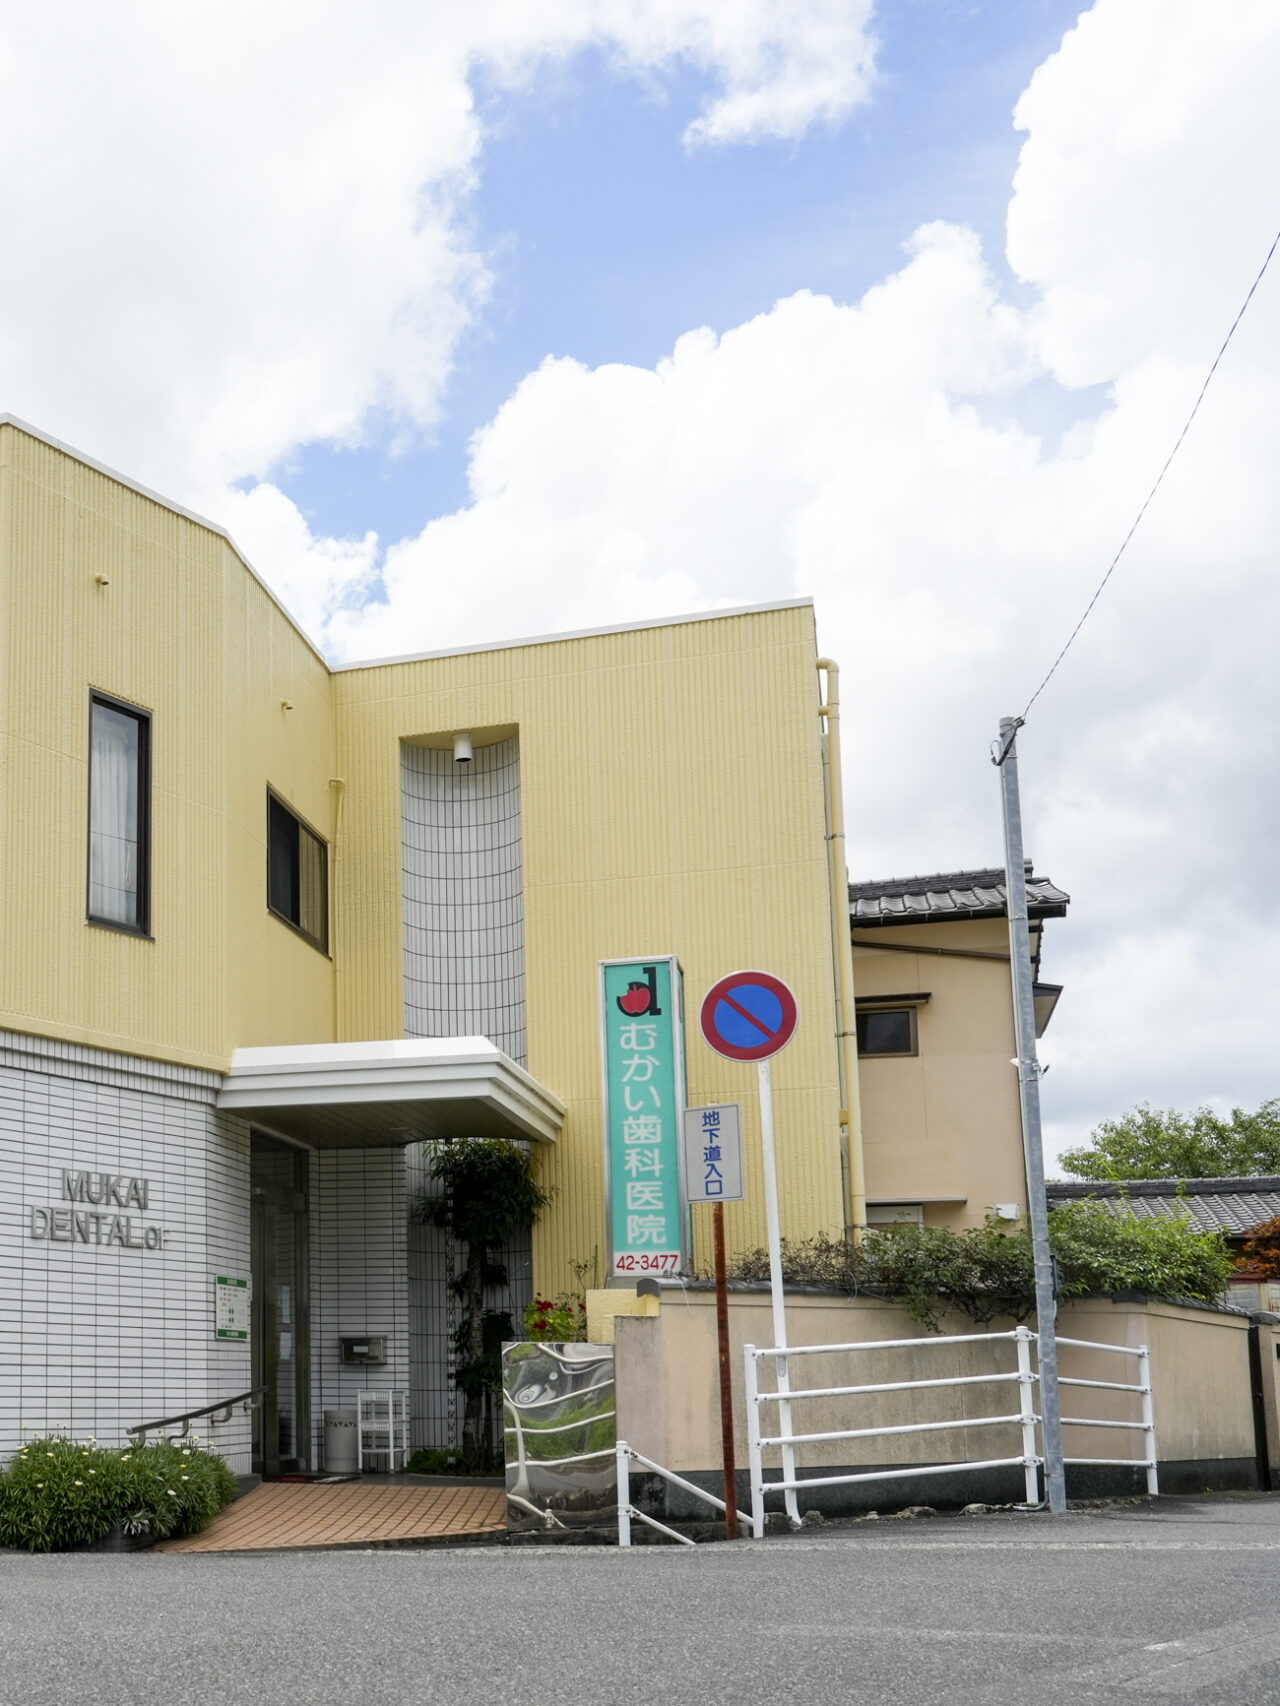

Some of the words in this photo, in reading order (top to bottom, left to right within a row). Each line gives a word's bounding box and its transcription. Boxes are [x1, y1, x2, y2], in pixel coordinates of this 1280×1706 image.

[620, 1022, 667, 1245] むかい歯科医院
[702, 1110, 723, 1196] 地下道入口
[62, 1168, 149, 1210] MUKAI
[31, 1205, 144, 1249] DENTAL
[616, 1254, 679, 1271] 42-3477
